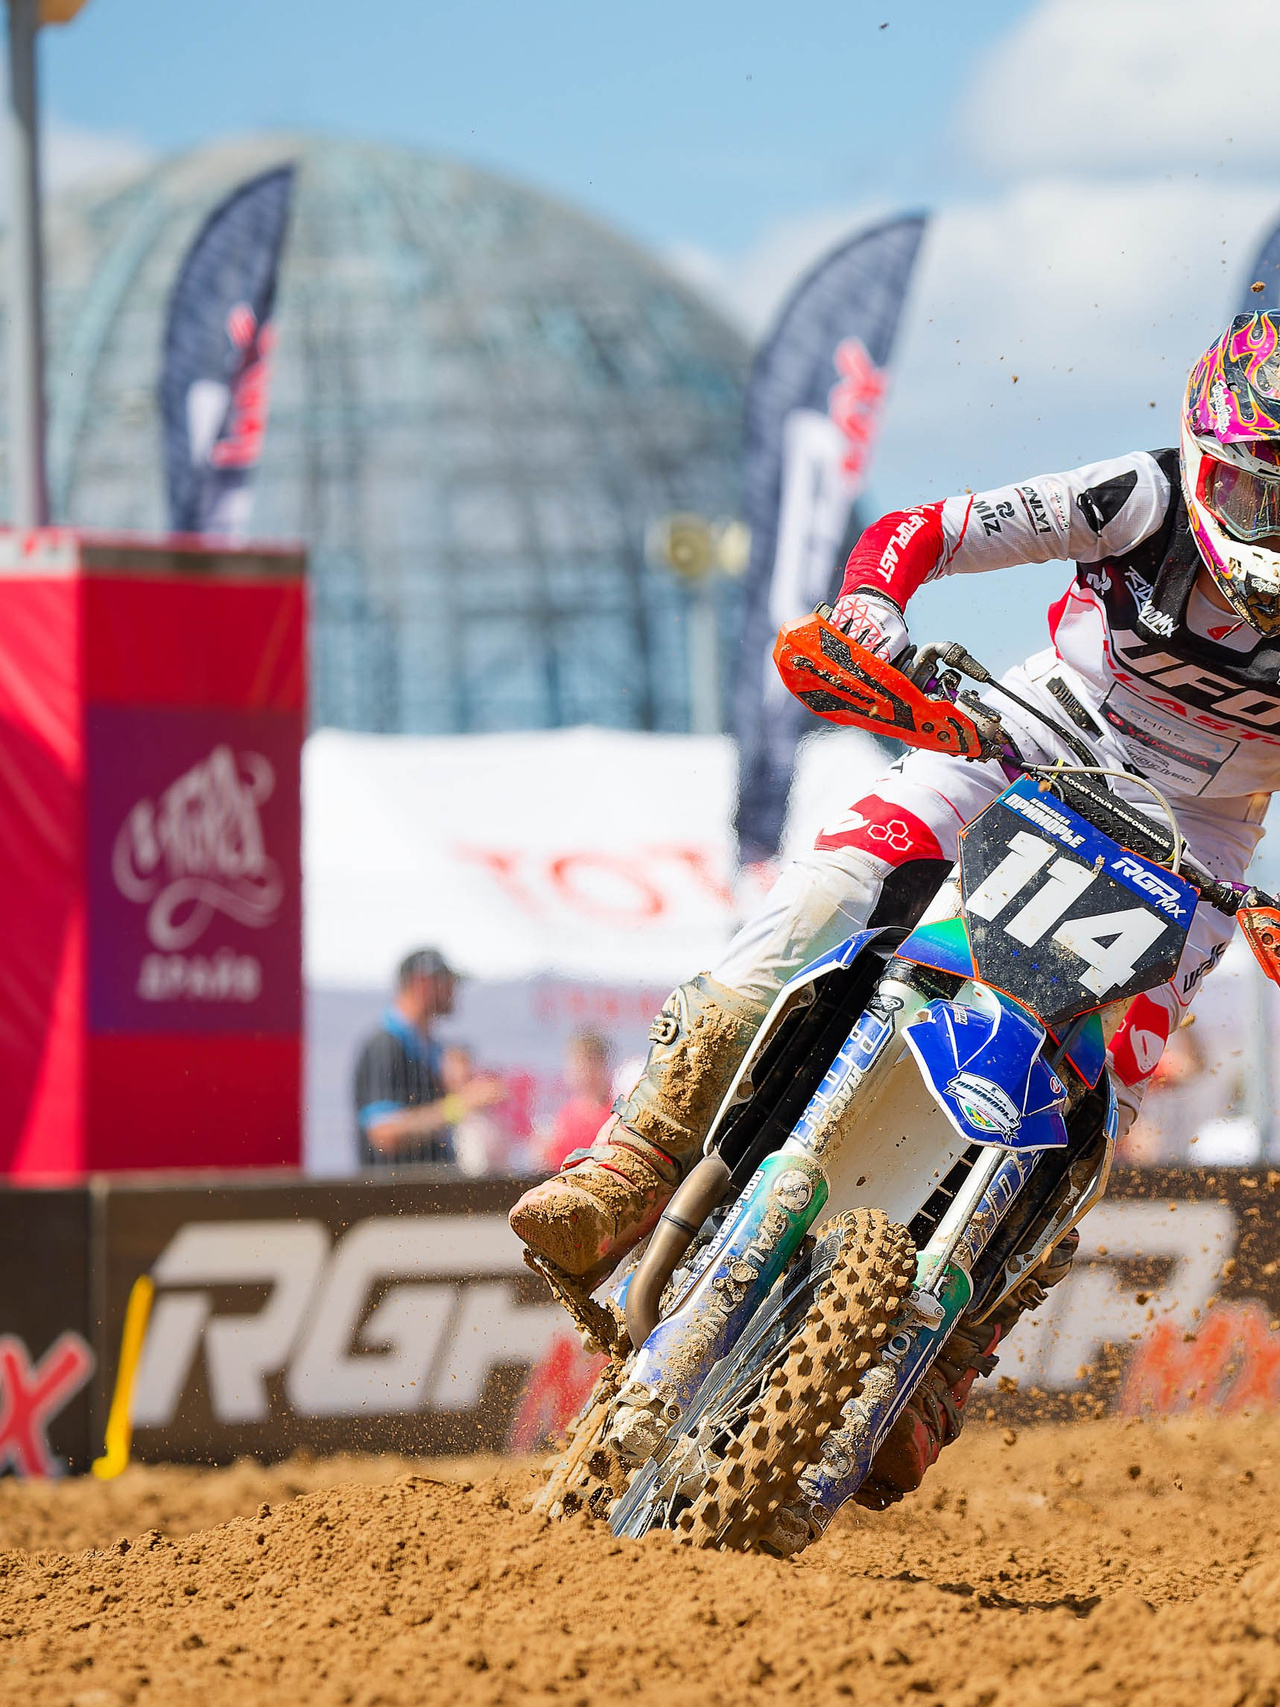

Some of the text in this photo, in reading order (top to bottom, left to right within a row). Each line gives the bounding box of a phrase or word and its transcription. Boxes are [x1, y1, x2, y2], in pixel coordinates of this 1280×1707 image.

[972, 499, 1003, 537] MIZ
[1003, 792, 1087, 849] ПРИМОРЬЕ
[1062, 775, 1171, 848] BOOST YOUR PERFORMANCE
[965, 829, 1169, 998] 114
[1154, 897, 1188, 919] MX
